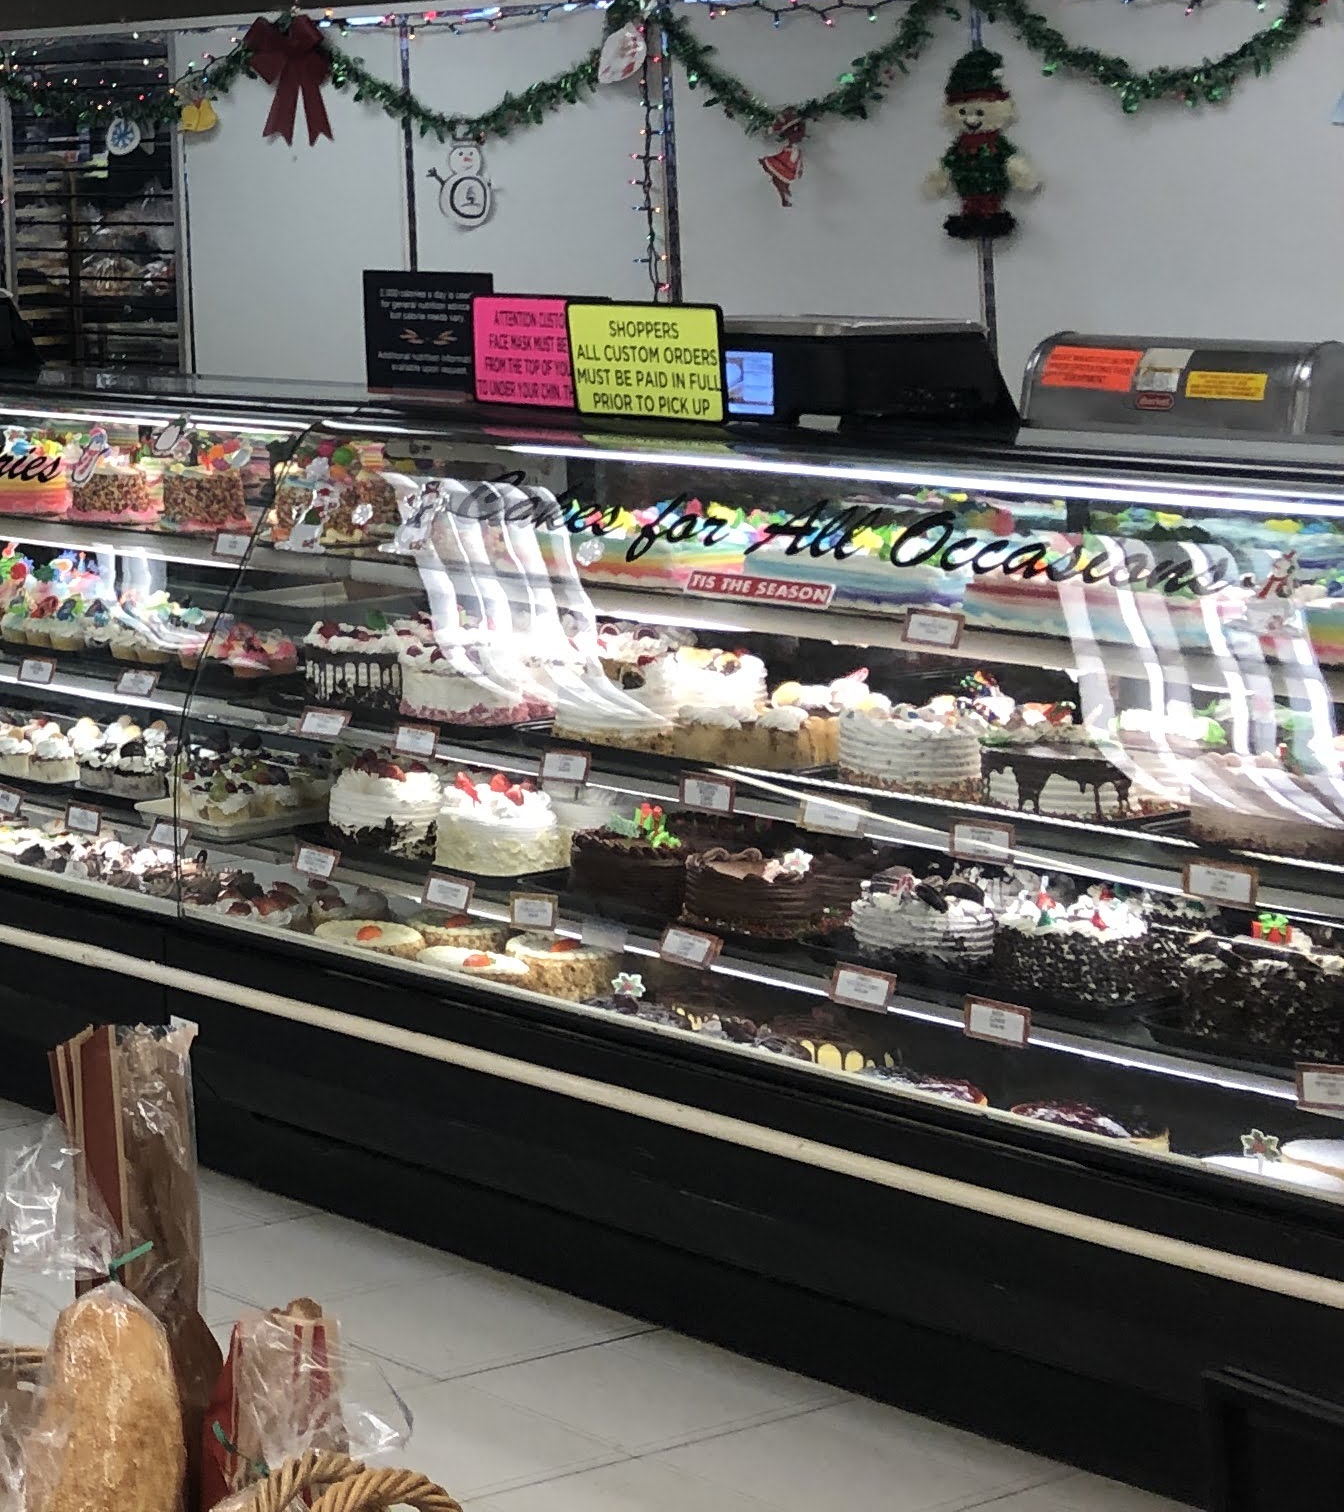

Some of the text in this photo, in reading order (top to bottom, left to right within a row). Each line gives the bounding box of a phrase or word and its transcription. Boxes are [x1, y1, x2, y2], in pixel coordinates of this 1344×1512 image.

[494, 311, 566, 329] ATTENTION CUSTO
[609, 320, 680, 339] SHOPPERS
[489, 333, 509, 349] FACE
[510, 335, 532, 350] MASK
[534, 336, 555, 351] MUST
[485, 356, 507, 372] FROM
[508, 357, 523, 372] THE
[524, 358, 540, 374] TOP
[542, 360, 553, 374] OF
[577, 344, 718, 366] ALL CUSTOM ORDERS
[478, 379, 488, 394] TO
[490, 380, 516, 397] UNDER
[517, 381, 540, 398] YOUR
[577, 368, 722, 391] MUST BE PAID IN FULL
[593, 392, 632, 410] PRIOR
[635, 395, 654, 412] TO
[659, 396, 688, 414] PICK
[693, 398, 710, 416] UP
[626, 492, 730, 562] for
[744, 498, 881, 559] All
[720, 577, 752, 593] THE
[756, 581, 829, 602] SEASON
